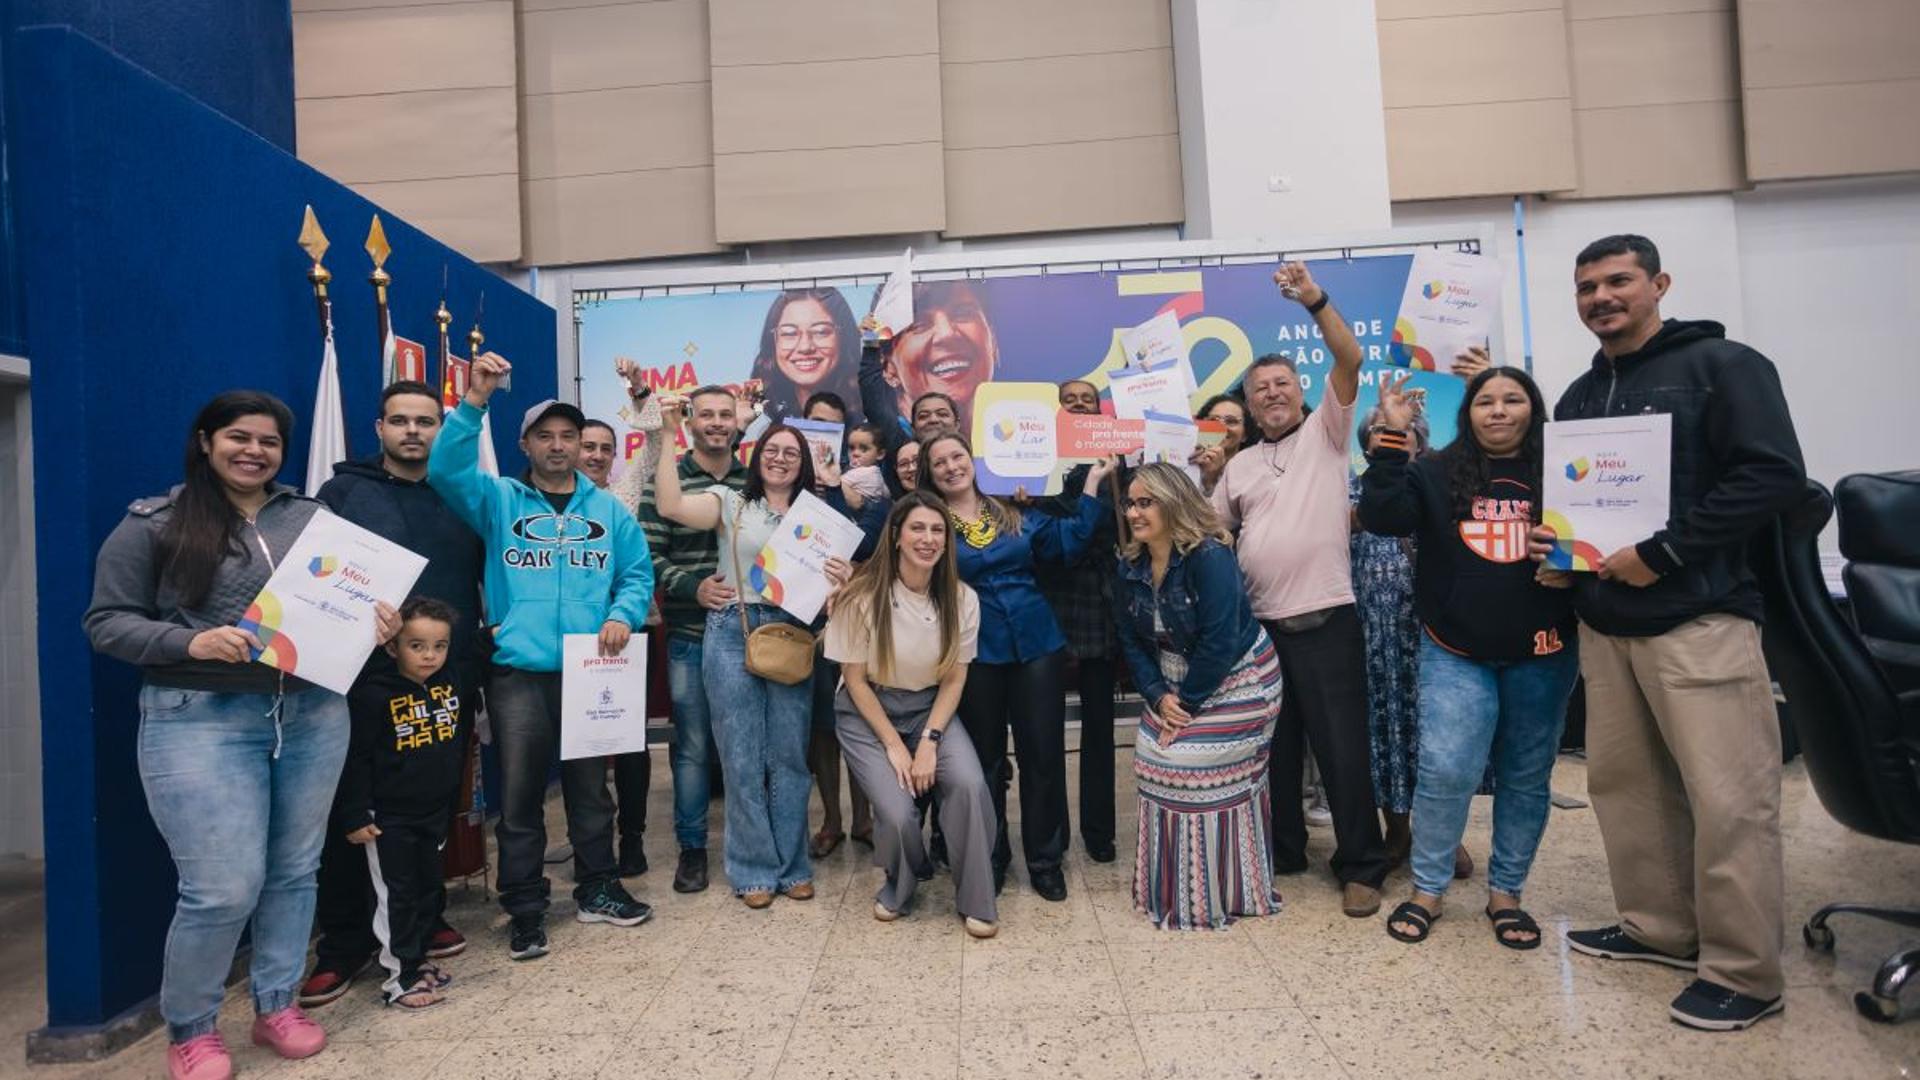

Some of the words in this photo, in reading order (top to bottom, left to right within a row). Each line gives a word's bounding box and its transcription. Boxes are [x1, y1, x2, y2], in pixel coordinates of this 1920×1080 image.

[1278, 324, 1324, 341] ANO
[1353, 319, 1383, 337] DE
[1019, 421, 1045, 432] Meu
[1021, 432, 1048, 445] Lar
[1595, 460, 1627, 469] Meu
[1595, 470, 1647, 487] Lugar
[503, 546, 611, 570] OAKLEY
[341, 565, 371, 586] Meu
[333, 578, 377, 603] Lugar
[389, 684, 453, 716] PLAY
